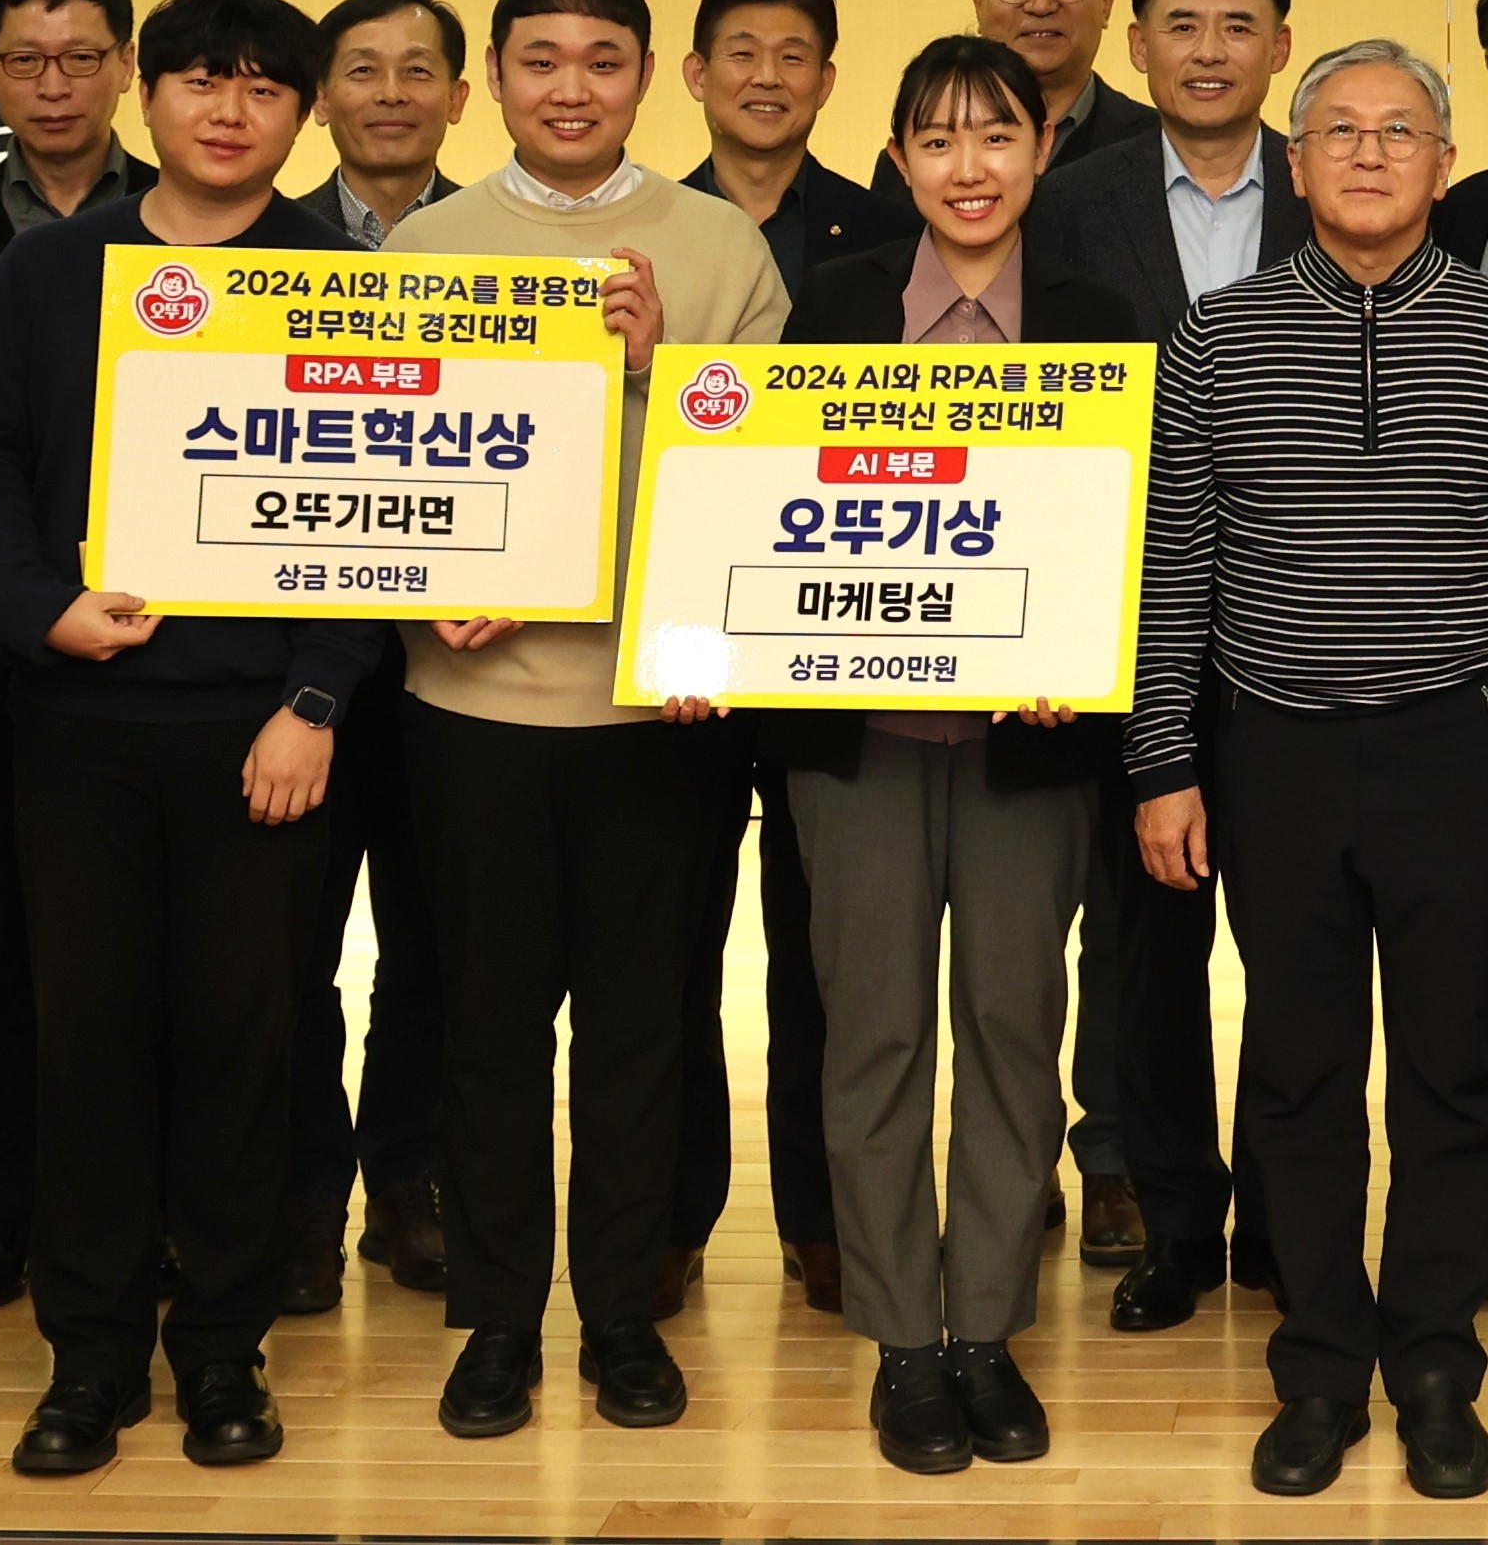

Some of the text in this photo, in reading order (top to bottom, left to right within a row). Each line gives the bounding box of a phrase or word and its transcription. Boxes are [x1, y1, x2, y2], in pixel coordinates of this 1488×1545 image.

[227, 269, 600, 306] 2024 AI와 RPA를 활용한
[149, 300, 195, 322] 오뚜기
[287, 309, 536, 344] 업무혁신 경진대회
[304, 362, 421, 388] RPA 부문
[766, 363, 1127, 392] 2024 AI와 RPA를 활용한
[693, 399, 737, 415] 오뚜기
[822, 401, 1063, 431] 업무혁신 경진대회
[183, 407, 535, 470] 스마트혁신상
[848, 453, 934, 477] AI 부문
[251, 491, 453, 535] 오뚜기라면
[773, 499, 1001, 556] 오뚜기상
[275, 564, 427, 592] 상금 50만원
[798, 582, 953, 622] 마케팅실
[789, 655, 957, 682] 상금 200만원
